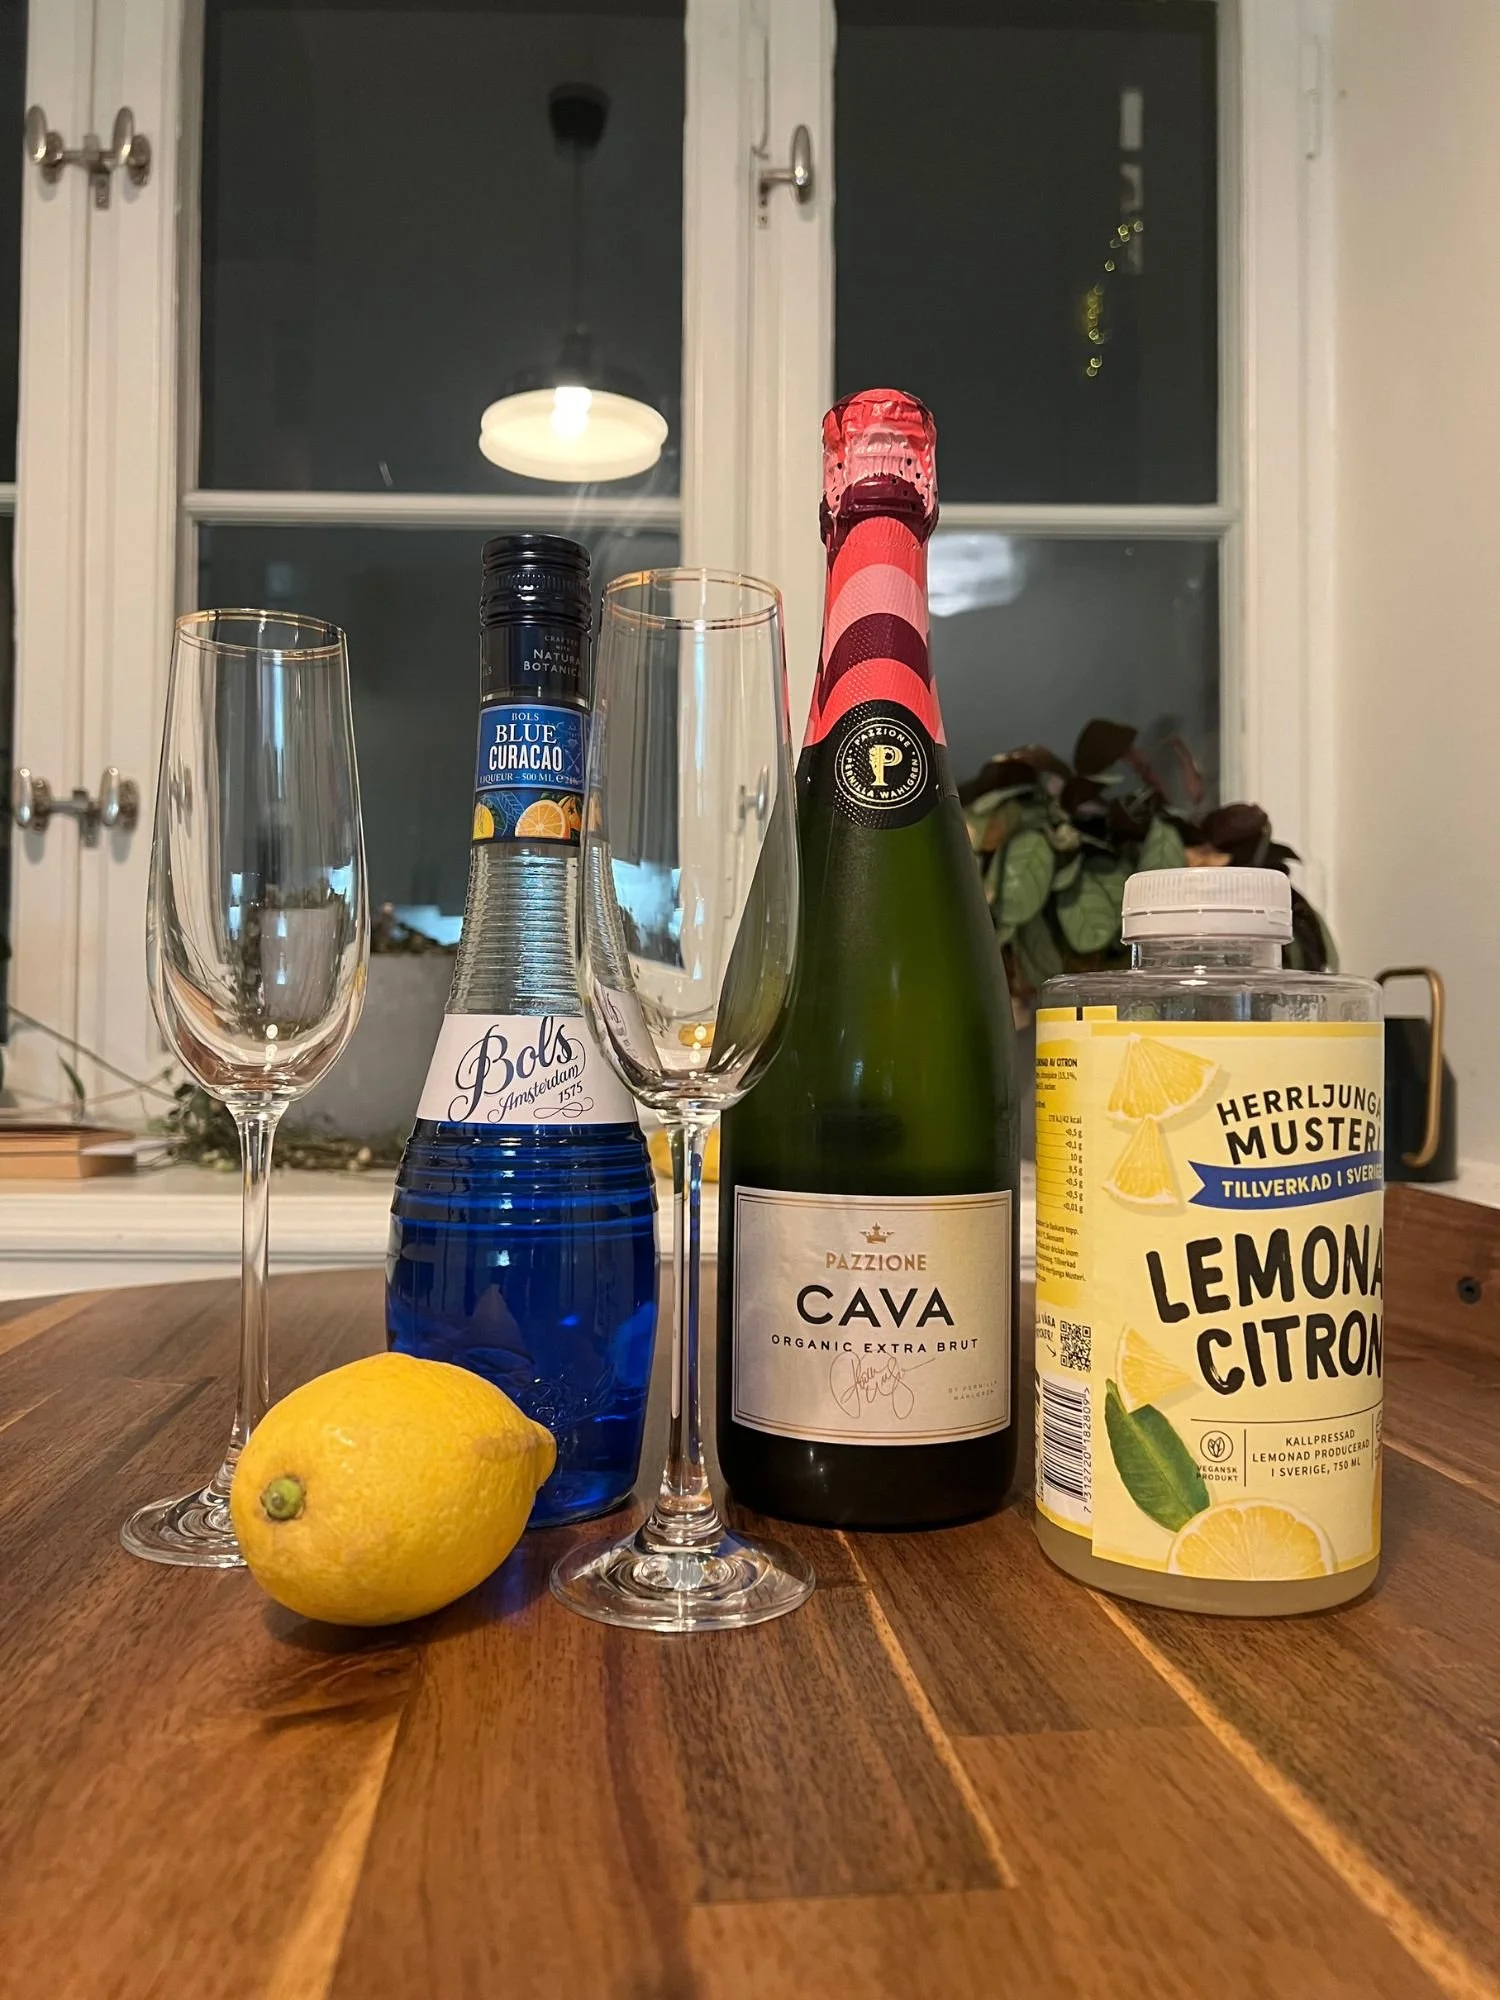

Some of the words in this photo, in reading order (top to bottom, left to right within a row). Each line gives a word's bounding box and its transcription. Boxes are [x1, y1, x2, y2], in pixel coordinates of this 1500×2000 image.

[511, 712, 540, 721] BOLS
[495, 723, 557, 744] BLUE
[854, 727, 911, 749] PAZZIONE
[489, 744, 563, 771] CURACAO
[480, 772, 514, 785] LIQUEUR
[522, 773, 537, 782] 500
[538, 773, 554, 782] ML
[844, 757, 875, 798] PERNILLA
[879, 758, 919, 799] WAHLGREN
[448, 1016, 583, 1123] Bols
[489, 1064, 580, 1121] Amsterdam
[557, 1081, 583, 1104] 1575
[1070, 1153, 1078, 1161] 10
[1222, 1173, 1332, 1198] TILLVERKAD
[1337, 1171, 1342, 1187] I
[826, 1252, 927, 1271] PAZZIONE
[797, 1285, 955, 1328] CAVA
[771, 1334, 852, 1353] ORGANIC
[864, 1343, 927, 1353] EXTRA
[937, 1338, 979, 1353] BRUT
[1197, 1310, 1382, 1395] CITRON
[1083, 1400, 1091, 1443] 182809
[1285, 1429, 1355, 1447] KALLPRESSAD
[1252, 1452, 1310, 1463] LEMONAD
[1314, 1439, 1370, 1459] PRODUCERAD
[1083, 1453, 1091, 1500] 312720
[1271, 1468, 1275, 1477] I
[1279, 1465, 1331, 1478] SVERIGE,
[1333, 1461, 1349, 1472] 750
[1351, 1457, 1361, 1468] ML
